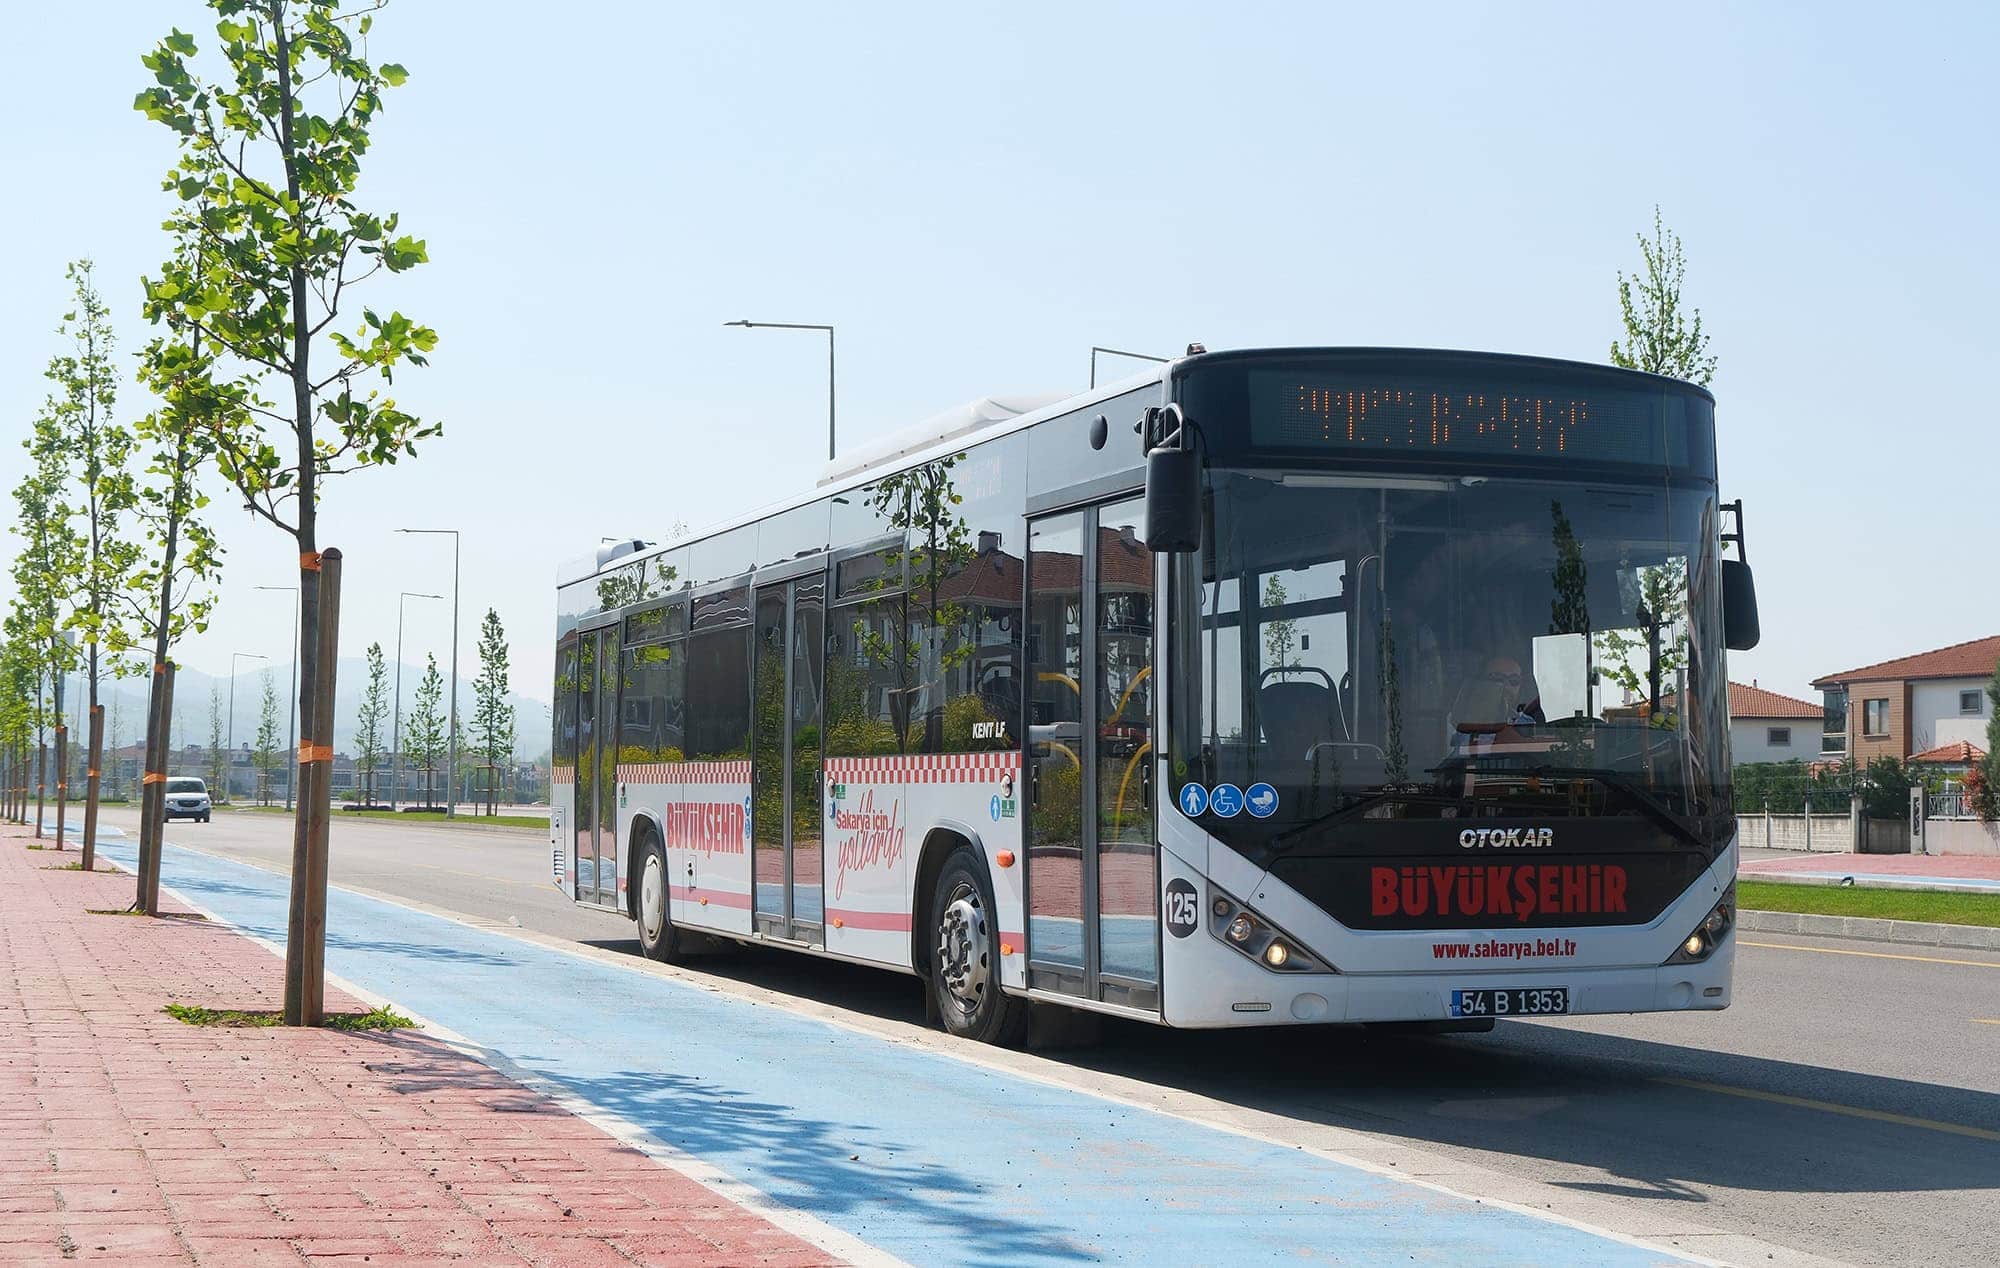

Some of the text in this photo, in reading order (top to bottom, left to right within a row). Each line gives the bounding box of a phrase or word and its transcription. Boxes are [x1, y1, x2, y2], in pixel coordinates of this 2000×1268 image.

[972, 721, 1006, 739] KENT LF
[836, 809, 889, 834] Sakarya için
[836, 789, 904, 901] yollarda
[1459, 828, 1553, 848] OTOKAR
[1166, 891, 1197, 925] 125
[1432, 938, 1577, 960] www.sakarya.bel.tr
[1462, 991, 1486, 1014] 54
[1495, 991, 1509, 1014] B
[1518, 990, 1564, 1012] 1353
